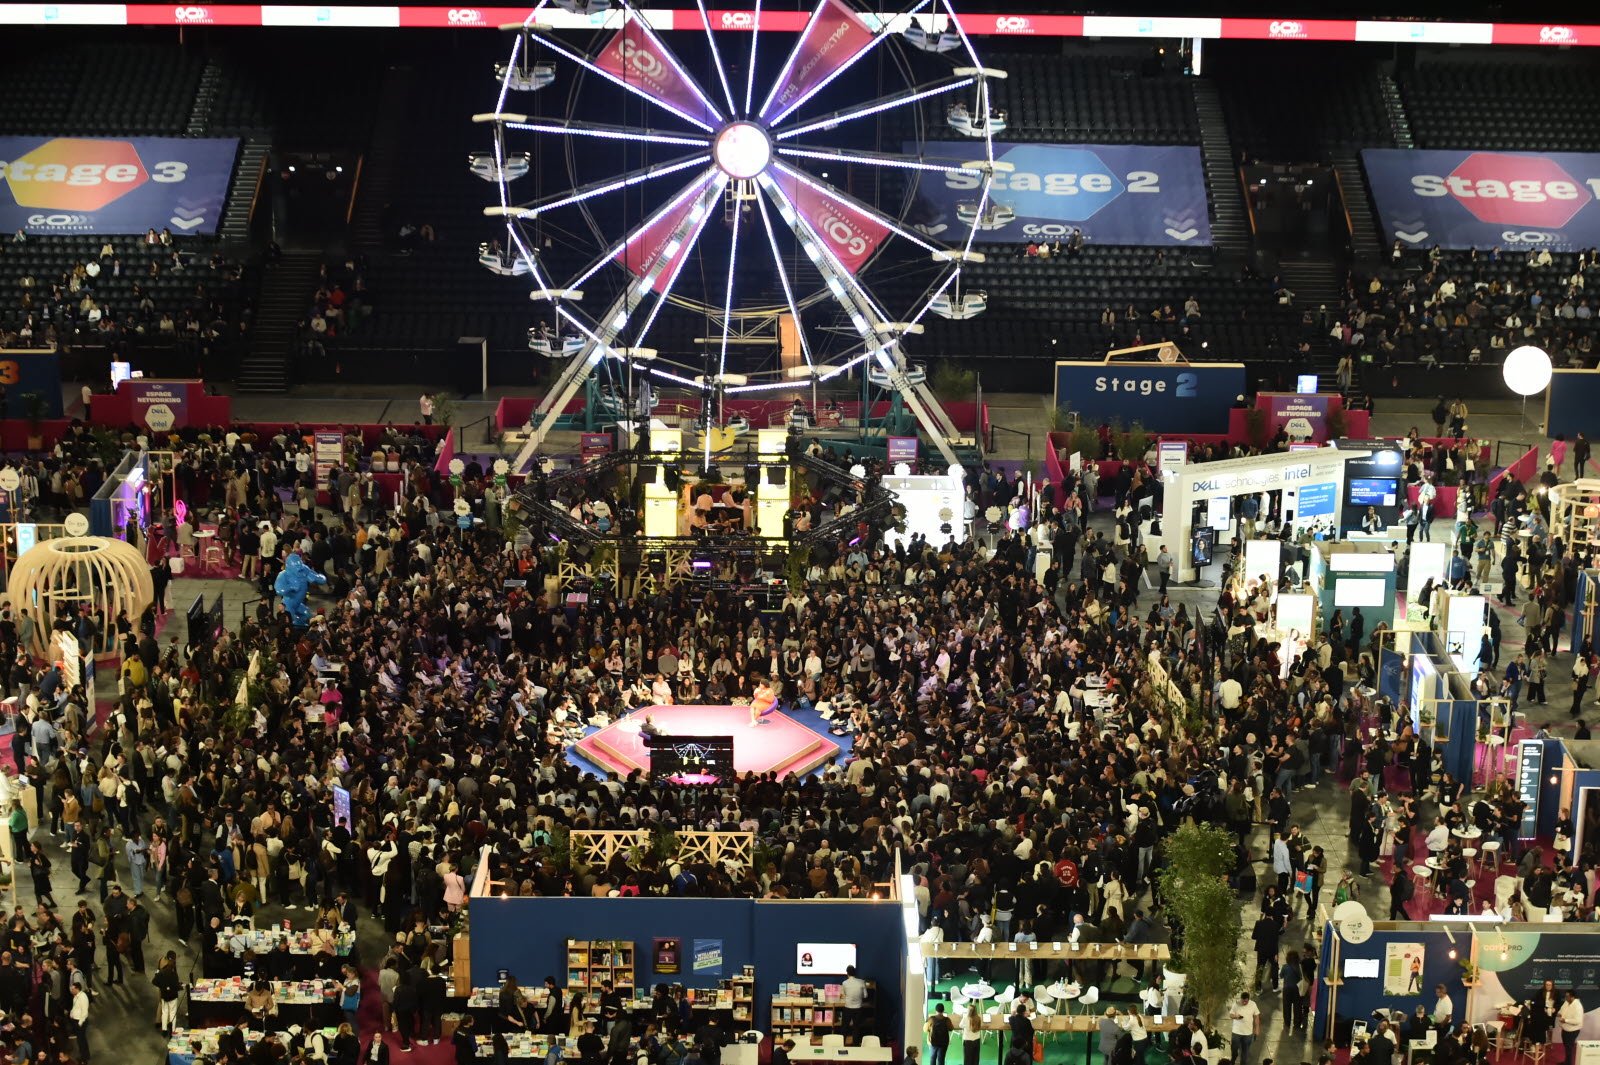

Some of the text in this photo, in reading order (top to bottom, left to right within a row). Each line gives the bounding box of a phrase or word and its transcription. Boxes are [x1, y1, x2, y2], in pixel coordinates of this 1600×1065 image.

[0, 160, 188, 186] tage 3
[1126, 171, 1160, 193] 2
[1411, 175, 1579, 203] Stage
[1165, 348, 1173, 361] 2
[1095, 373, 1198, 397] Stage 2
[1193, 465, 1311, 492] DELL echnologies intel
